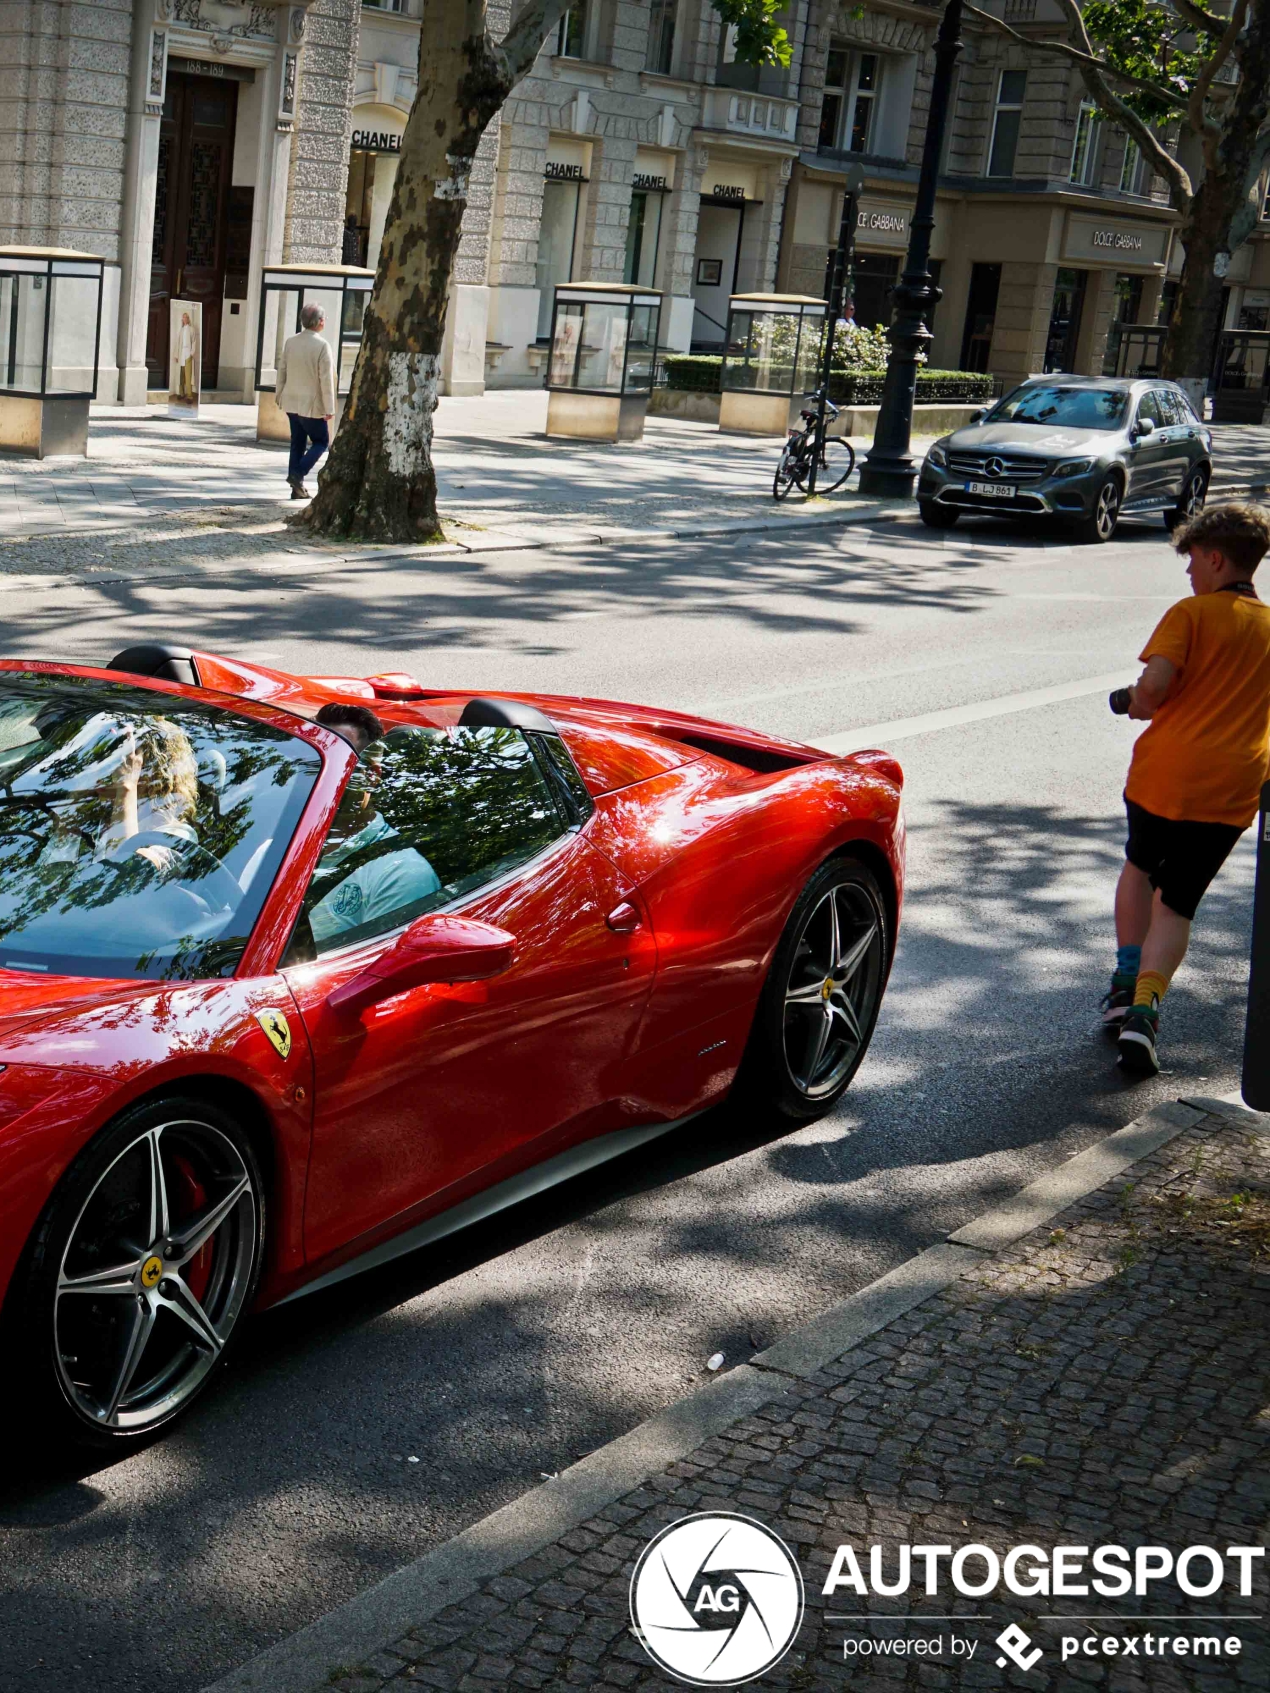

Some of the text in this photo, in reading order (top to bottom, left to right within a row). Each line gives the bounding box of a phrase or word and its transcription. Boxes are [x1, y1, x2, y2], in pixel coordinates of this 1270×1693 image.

[352, 129, 402, 149] CHANEL
[545, 161, 585, 178] CHANEL
[632, 172, 668, 189] CHANEL
[713, 183, 746, 199] CHANEL
[870, 213, 905, 231] GABBANA
[1094, 231, 1142, 250] DOLCE GABBANA
